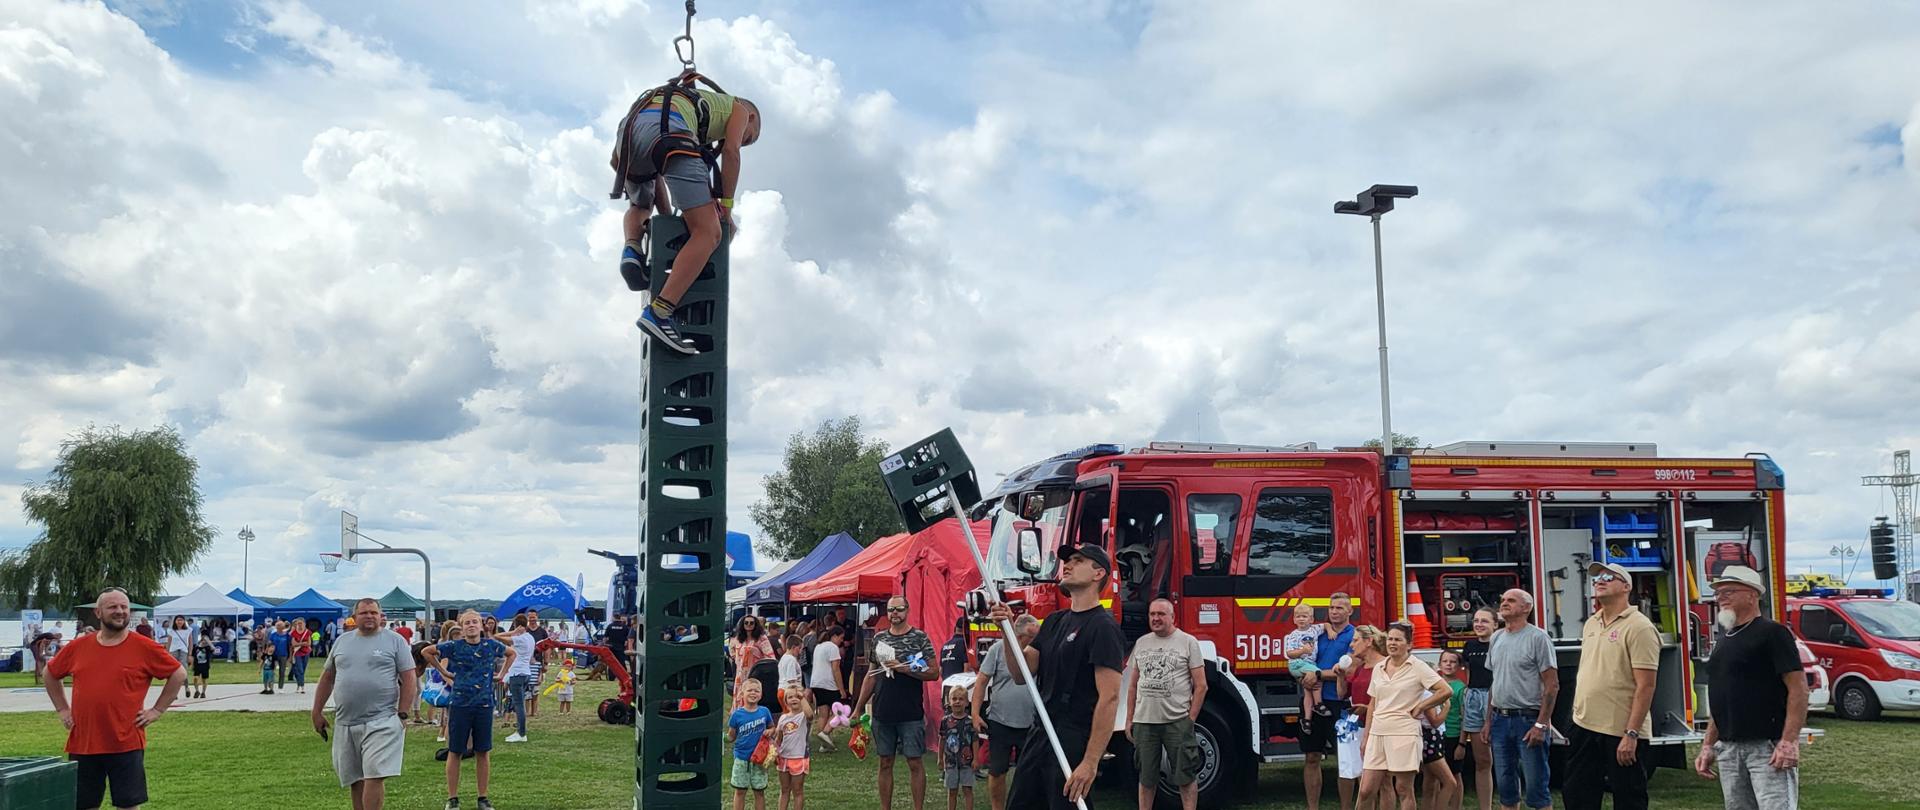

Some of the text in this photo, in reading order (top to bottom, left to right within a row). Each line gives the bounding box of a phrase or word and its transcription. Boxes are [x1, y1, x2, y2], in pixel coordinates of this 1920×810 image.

[1655, 469, 1671, 480] 998
[1680, 469, 1696, 480] 112
[523, 585, 559, 597] 800+
[1236, 634, 1271, 660] 518
